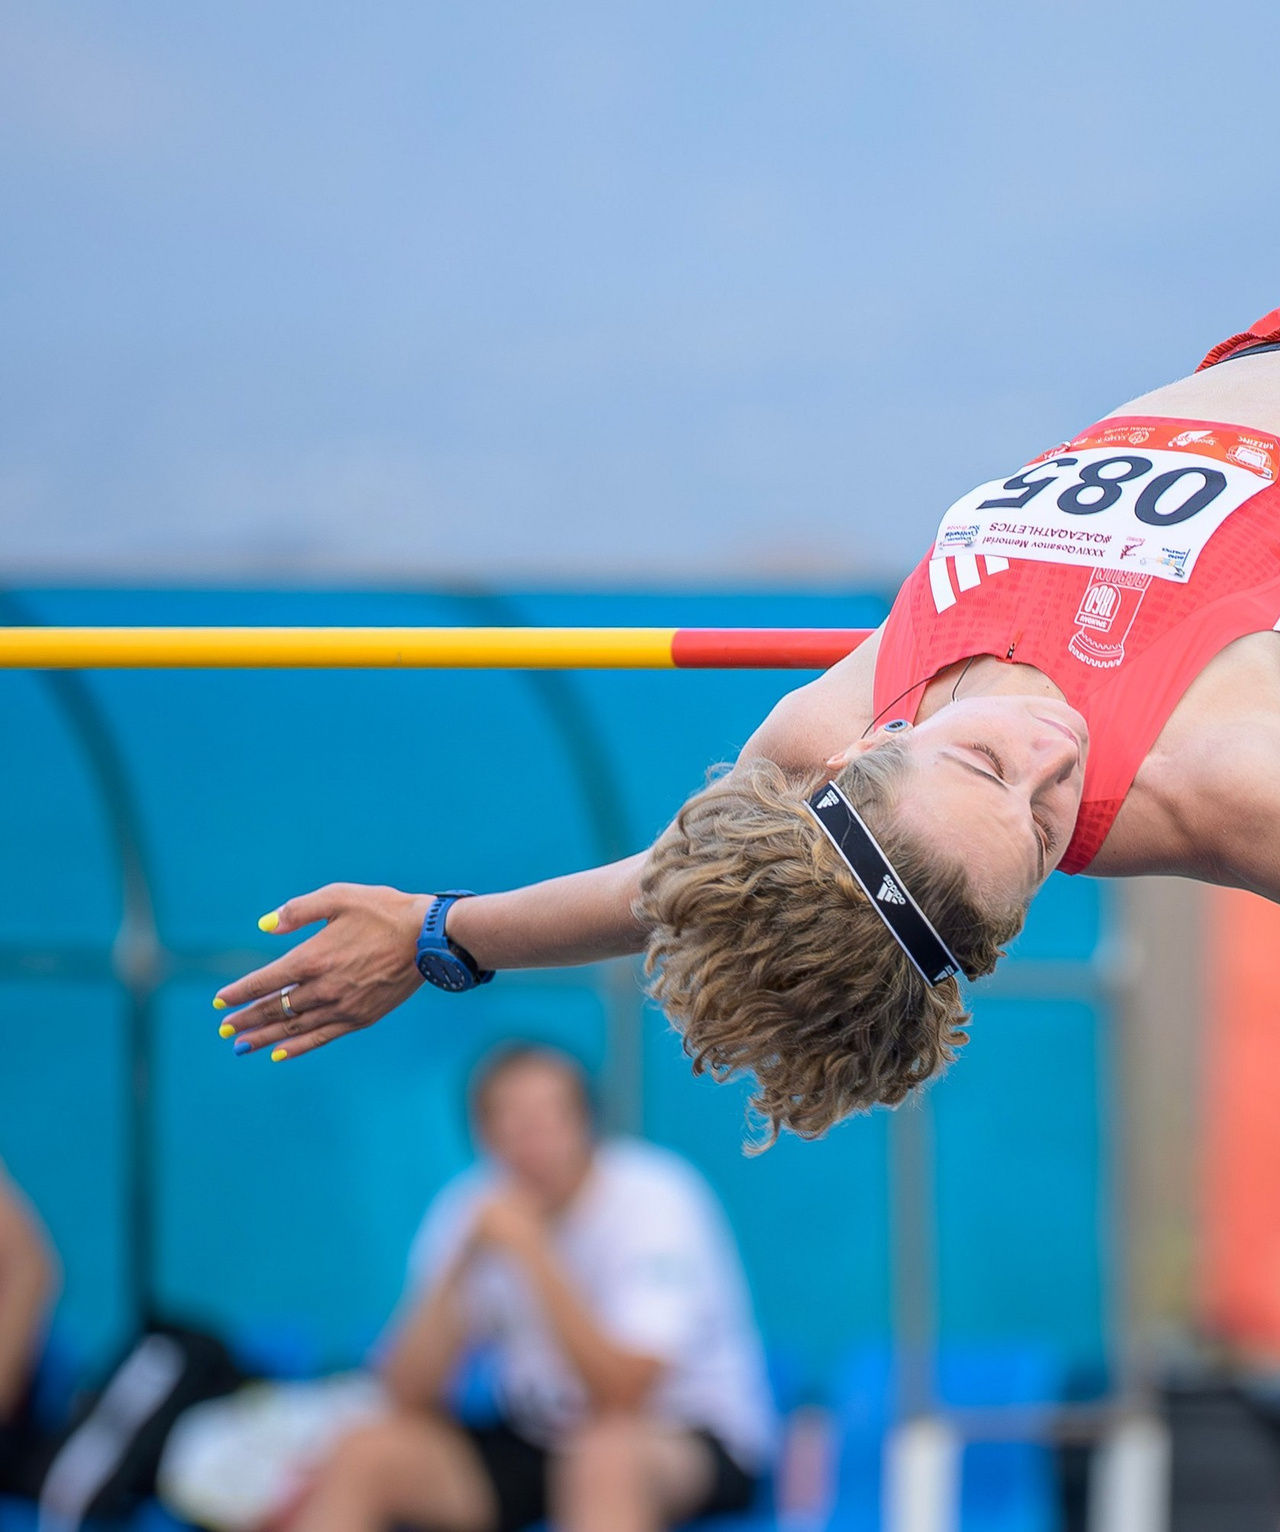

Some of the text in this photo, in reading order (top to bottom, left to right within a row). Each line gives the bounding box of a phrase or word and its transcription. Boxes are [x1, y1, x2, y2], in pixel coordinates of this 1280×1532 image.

[1237, 435, 1275, 450] KAZZINC
[975, 455, 1229, 527] 085
[988, 521, 1113, 544] #QAZAQATHLETICS
[982, 535, 1107, 559] XXXIV Qosanov Memorial
[1083, 584, 1117, 618] 1860
[882, 873, 907, 906] adidas
